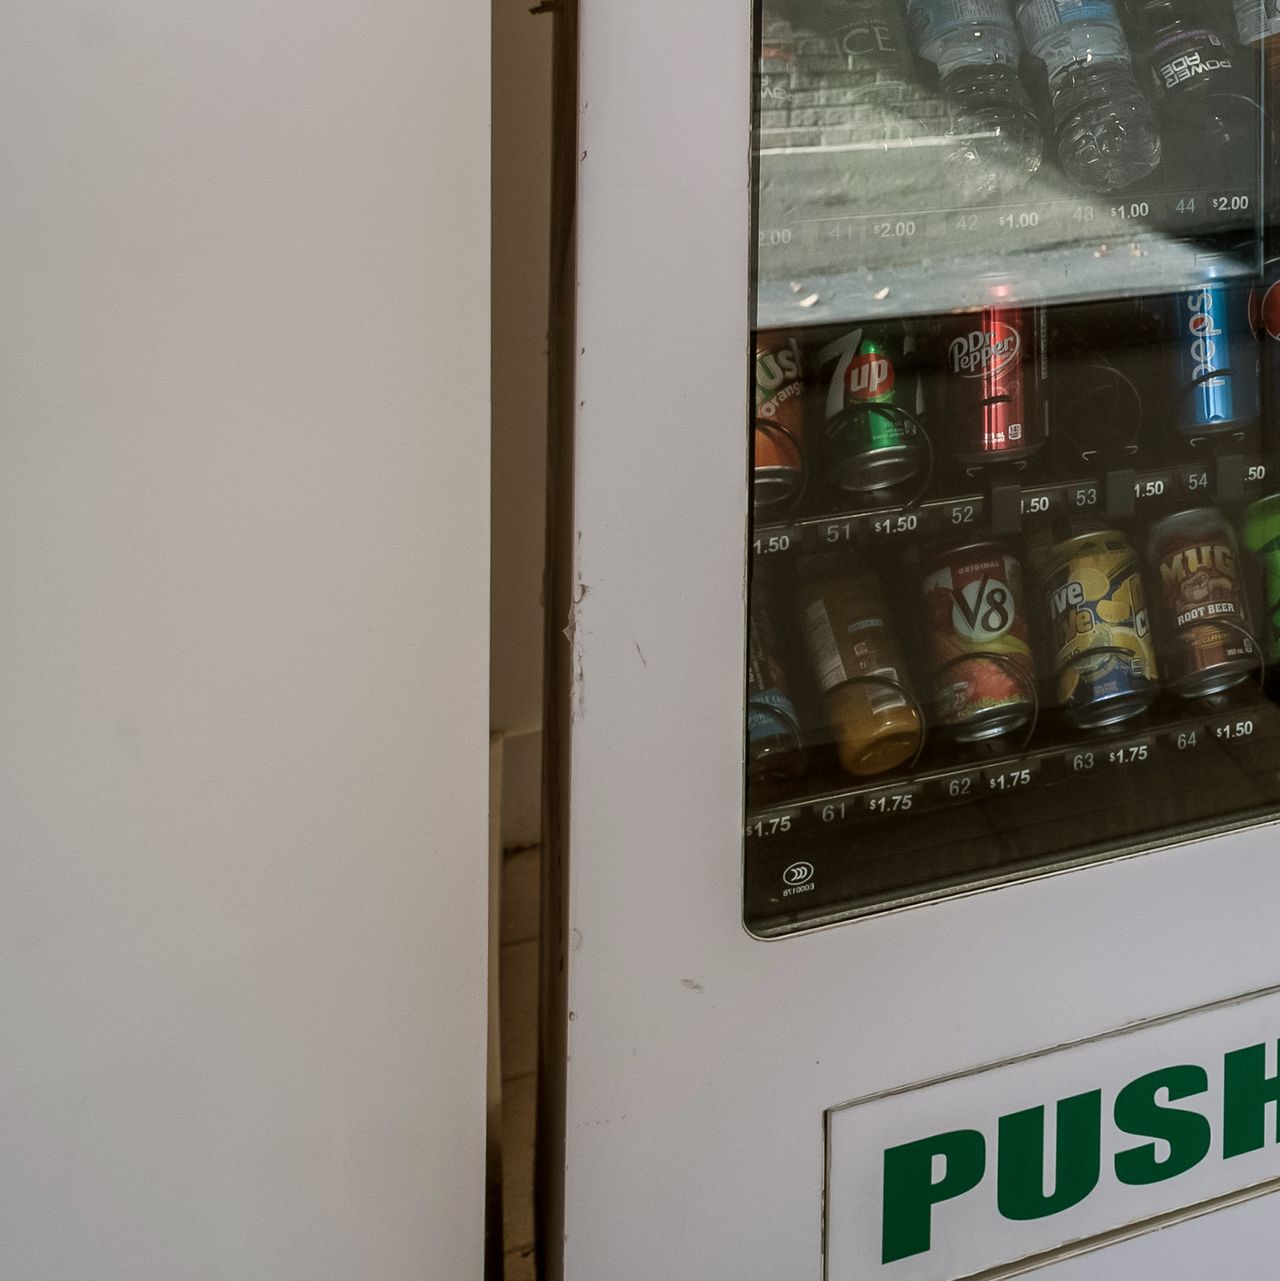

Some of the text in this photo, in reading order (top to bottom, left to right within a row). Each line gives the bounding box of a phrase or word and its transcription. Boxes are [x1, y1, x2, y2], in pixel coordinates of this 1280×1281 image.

[1159, 51, 1201, 79] ADE
[1165, 58, 1233, 89] POWER
[1072, 202, 1150, 221] 43 $1.00
[1175, 195, 1249, 214] 44 $2.00
[873, 221, 916, 238] $2.00
[956, 212, 1039, 231] 42 $1.00
[967, 330, 996, 352] Dr
[950, 335, 1015, 374] Pepper
[1075, 480, 1165, 506] 53 1.50
[1188, 473, 1209, 491] 54
[951, 505, 975, 524] 52
[753, 514, 918, 555] 1.50 51 $1.50
[958, 559, 1001, 575] ORIGINAL
[1159, 545, 1235, 583] MUG
[949, 574, 1010, 632] V8
[1177, 602, 1236, 626] ROOT BEER
[1177, 720, 1254, 749] 64 $1.50
[1073, 745, 1149, 771] 63 $1.75
[949, 769, 1031, 797] 62 $1.75
[746, 794, 913, 838] $1.75 61 $1.75
